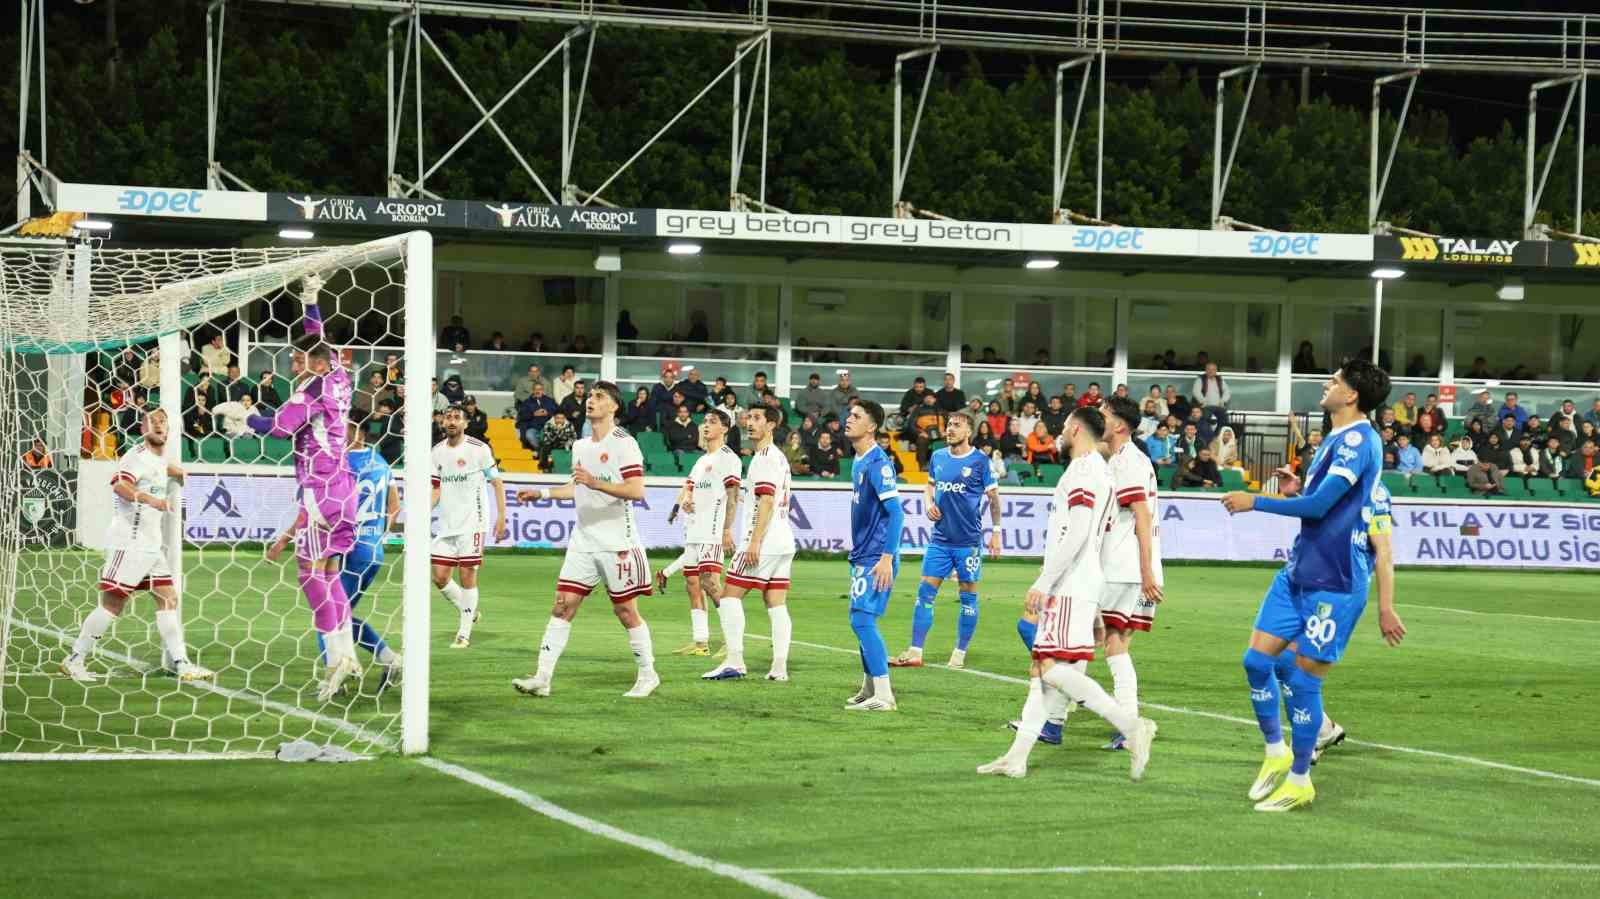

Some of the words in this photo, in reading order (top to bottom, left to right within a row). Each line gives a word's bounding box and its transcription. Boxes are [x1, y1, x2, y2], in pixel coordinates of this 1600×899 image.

[118, 190, 203, 214] opet
[329, 199, 354, 207] GRUP
[375, 200, 445, 217] ACROPOL
[526, 206, 550, 215] GRUP
[319, 206, 367, 221] AURA
[391, 215, 429, 223] BODRUM
[515, 213, 562, 229] AURA
[569, 209, 637, 225] ACROPOL
[585, 222, 621, 231] BODRUM
[666, 214, 736, 236] grey
[745, 213, 830, 235] beton
[850, 222, 919, 243] grey
[928, 221, 1011, 242] beton
[1072, 228, 1144, 251] opet
[1248, 234, 1320, 257] opet
[1438, 238, 1520, 255] TALAY
[1443, 254, 1513, 263] LOGISTICS
[936, 481, 967, 493] opet
[1411, 511, 1550, 530] KILAVUZ
[1417, 537, 1550, 561] ANADOLU
[616, 563, 632, 580] 14
[965, 556, 981, 572] 99
[1305, 615, 1337, 643] 90
